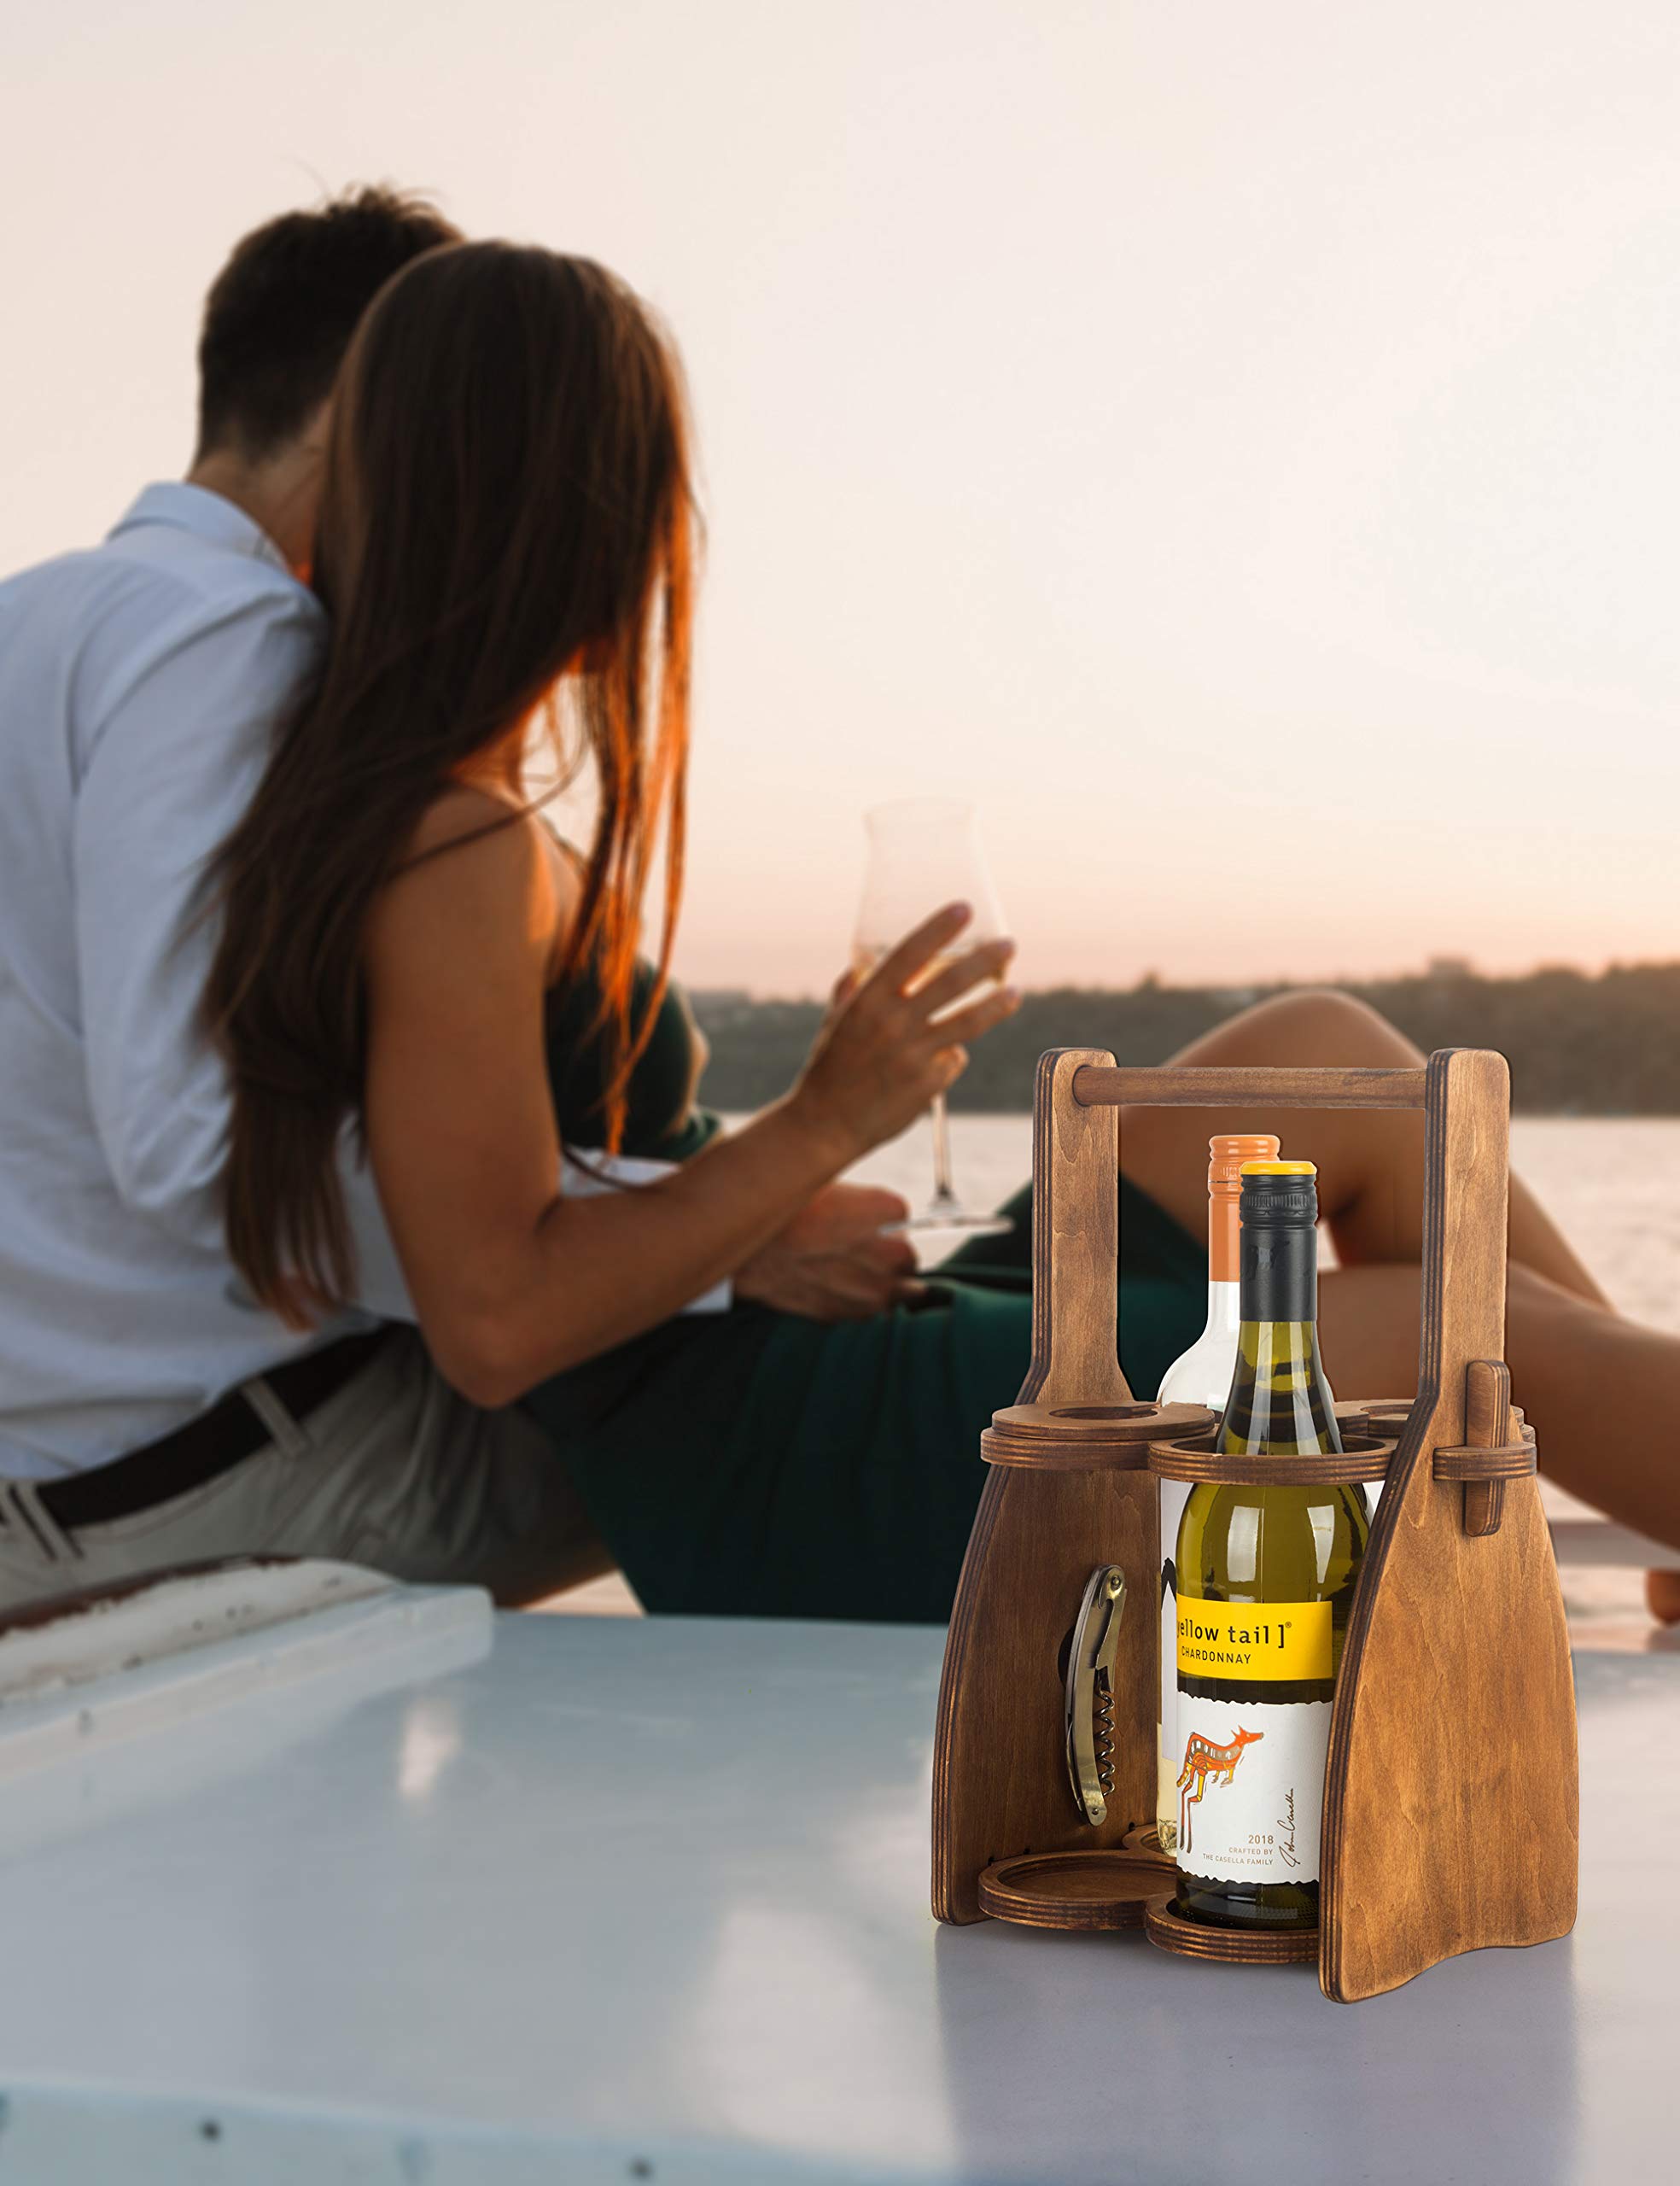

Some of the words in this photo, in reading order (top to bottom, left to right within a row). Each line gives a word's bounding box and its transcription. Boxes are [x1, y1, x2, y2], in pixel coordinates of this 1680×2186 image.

[1228, 1626, 1269, 1644] tail
[1182, 1645, 1251, 1663] CHARDONNAY
[1248, 1834, 1274, 1844] 2018
[1216, 1855, 1245, 1864] CASELLA
